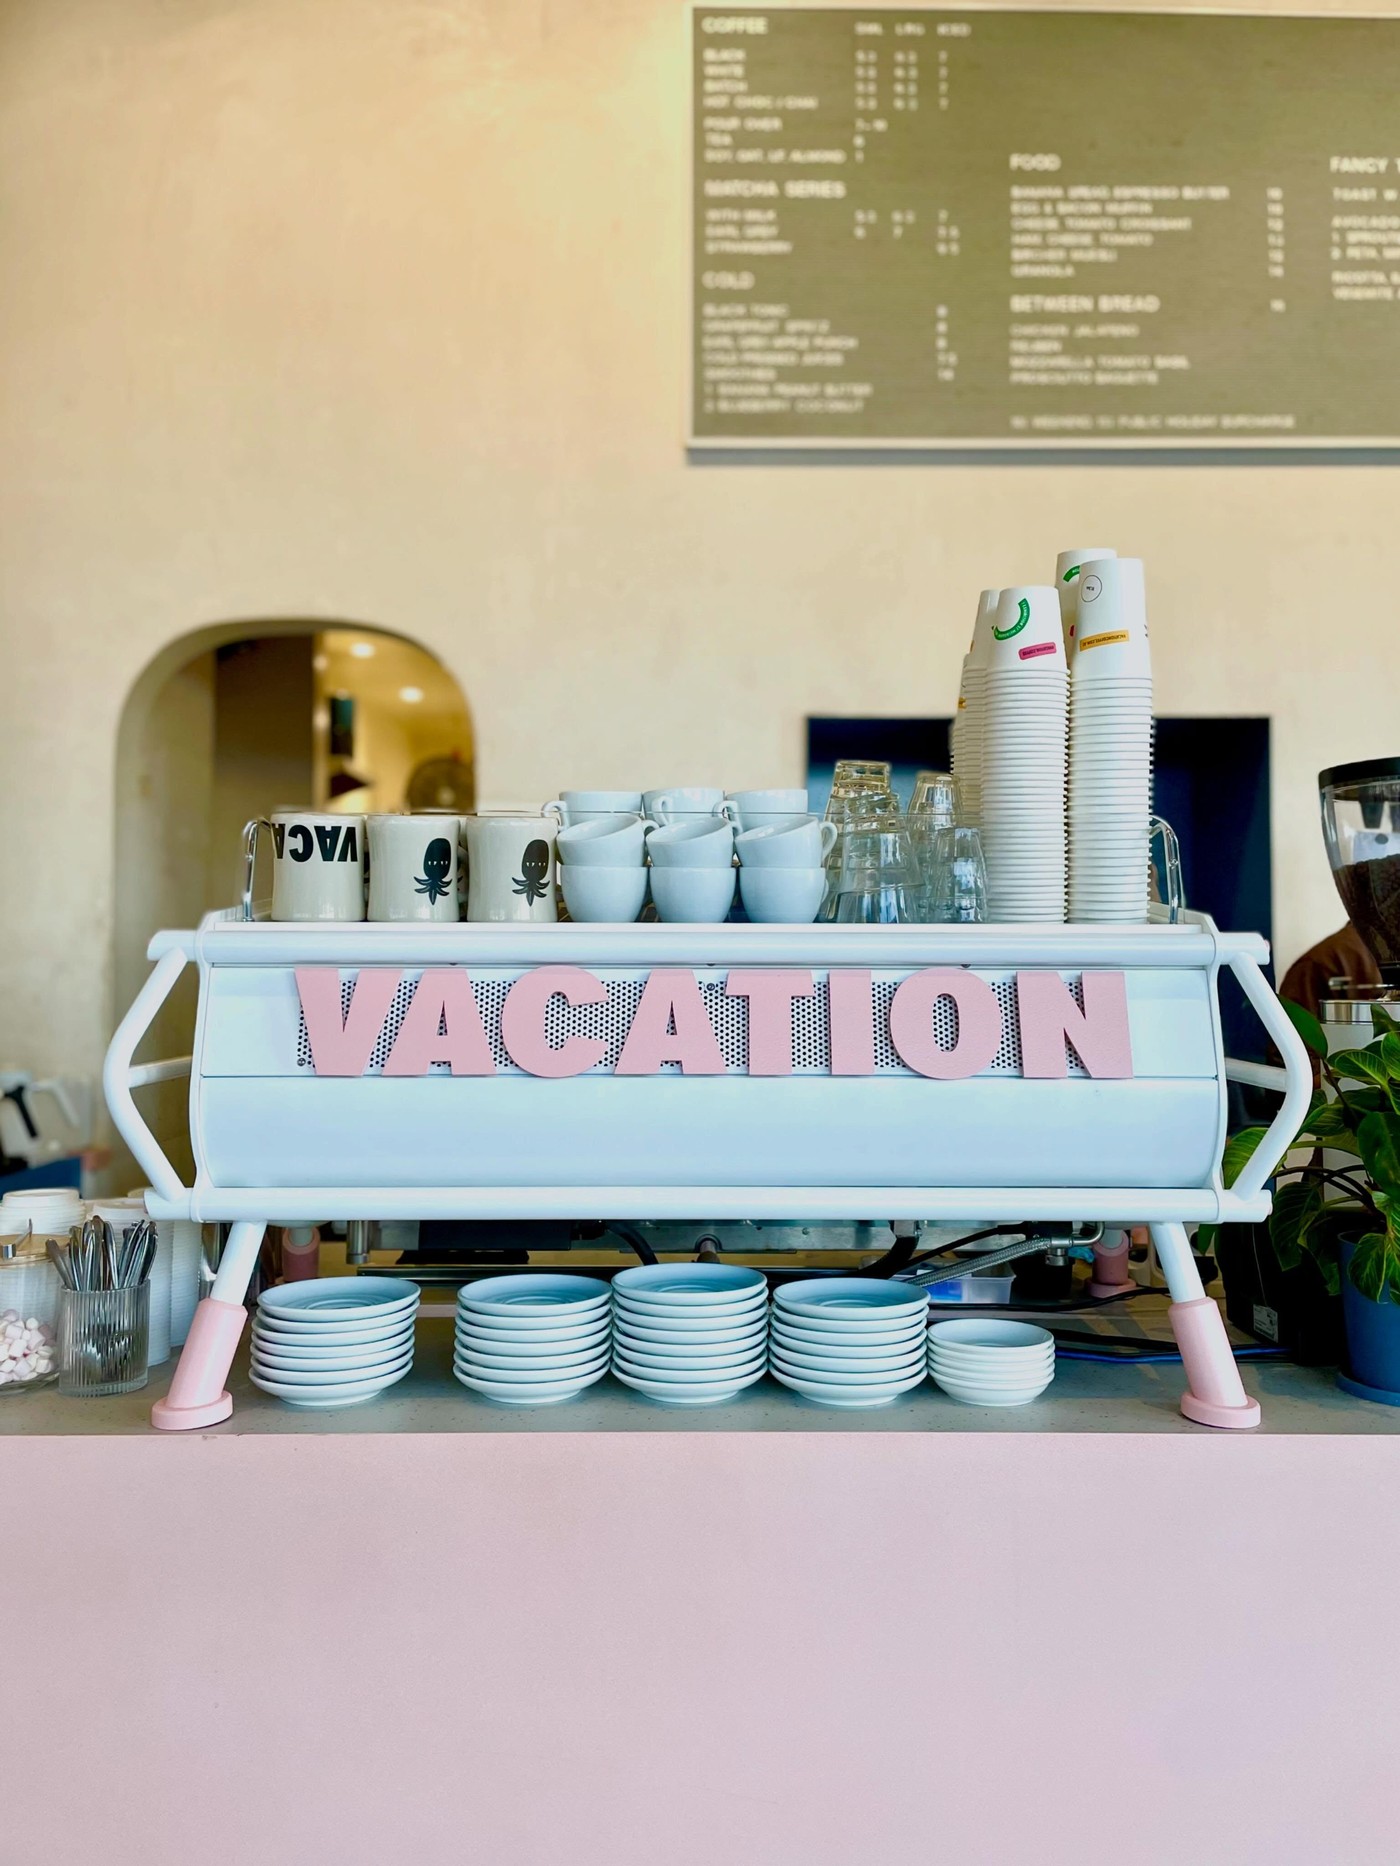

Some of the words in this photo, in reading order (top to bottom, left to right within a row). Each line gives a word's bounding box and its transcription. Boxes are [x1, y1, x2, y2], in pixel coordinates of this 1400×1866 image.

[702, 18, 767, 33] COFFEE
[895, 23, 924, 35] LRG
[704, 49, 746, 62] BLACK
[704, 65, 744, 77] WHITE
[704, 96, 729, 108] HOT
[734, 96, 773, 108] CHOC
[785, 96, 818, 108] CHAI
[704, 117, 740, 131] POUR
[744, 117, 782, 131] OVER
[706, 133, 733, 146] TEA
[789, 149, 846, 163] ALMOND
[1010, 154, 1061, 170] FOOD
[1330, 157, 1388, 173] FANCY
[705, 180, 779, 198] MATCHA
[785, 180, 846, 198] SERIES
[1011, 186, 1063, 199] BANANA
[1068, 186, 1110, 199] BREAD
[1113, 186, 1179, 199] ESPRESSO
[1182, 186, 1230, 199] BUTTER
[1333, 187, 1376, 201] TOAST
[1011, 202, 1039, 214] EGG
[1057, 202, 1101, 214] BACON
[1105, 202, 1153, 214] MUFFIN
[706, 209, 740, 222] WITH
[743, 209, 776, 222] MILK
[1065, 217, 1116, 230] TOMATO
[1120, 217, 1191, 230] CROISSANT
[706, 225, 739, 238] EARL
[743, 225, 778, 238] GREY
[1099, 233, 1153, 245] TOMATO
[705, 241, 792, 254] STRAWBERRY
[1070, 249, 1117, 261] MUESLI
[1011, 265, 1075, 277] GRANOLA
[703, 271, 755, 289] COLD
[703, 303, 746, 317] BLACK
[750, 303, 789, 317] TONIC
[1010, 295, 1093, 312] BETWEEN
[1098, 295, 1160, 312] BREAD
[1010, 324, 1069, 337] CHICKEN
[813, 336, 859, 349] PUNCH
[703, 352, 737, 365] COLD
[1010, 355, 1093, 369] MOZZARELLA
[1098, 355, 1150, 369] TOMATO
[1154, 355, 1190, 369] BASIL
[1010, 371, 1092, 384] PROSCIUTTO
[1095, 371, 1158, 384] BAGUETTE
[717, 383, 770, 397] BANANA
[773, 383, 820, 397] PEANUT
[824, 383, 873, 397] BUTTER
[717, 399, 790, 412] BLUEBERRY
[795, 399, 864, 412] COCONUT
[1118, 416, 1161, 429] PUBLIC
[1165, 416, 1216, 429] HOLIDAY
[1221, 416, 1295, 429] SURCHARGE
[294, 966, 1133, 1080] VACATION
